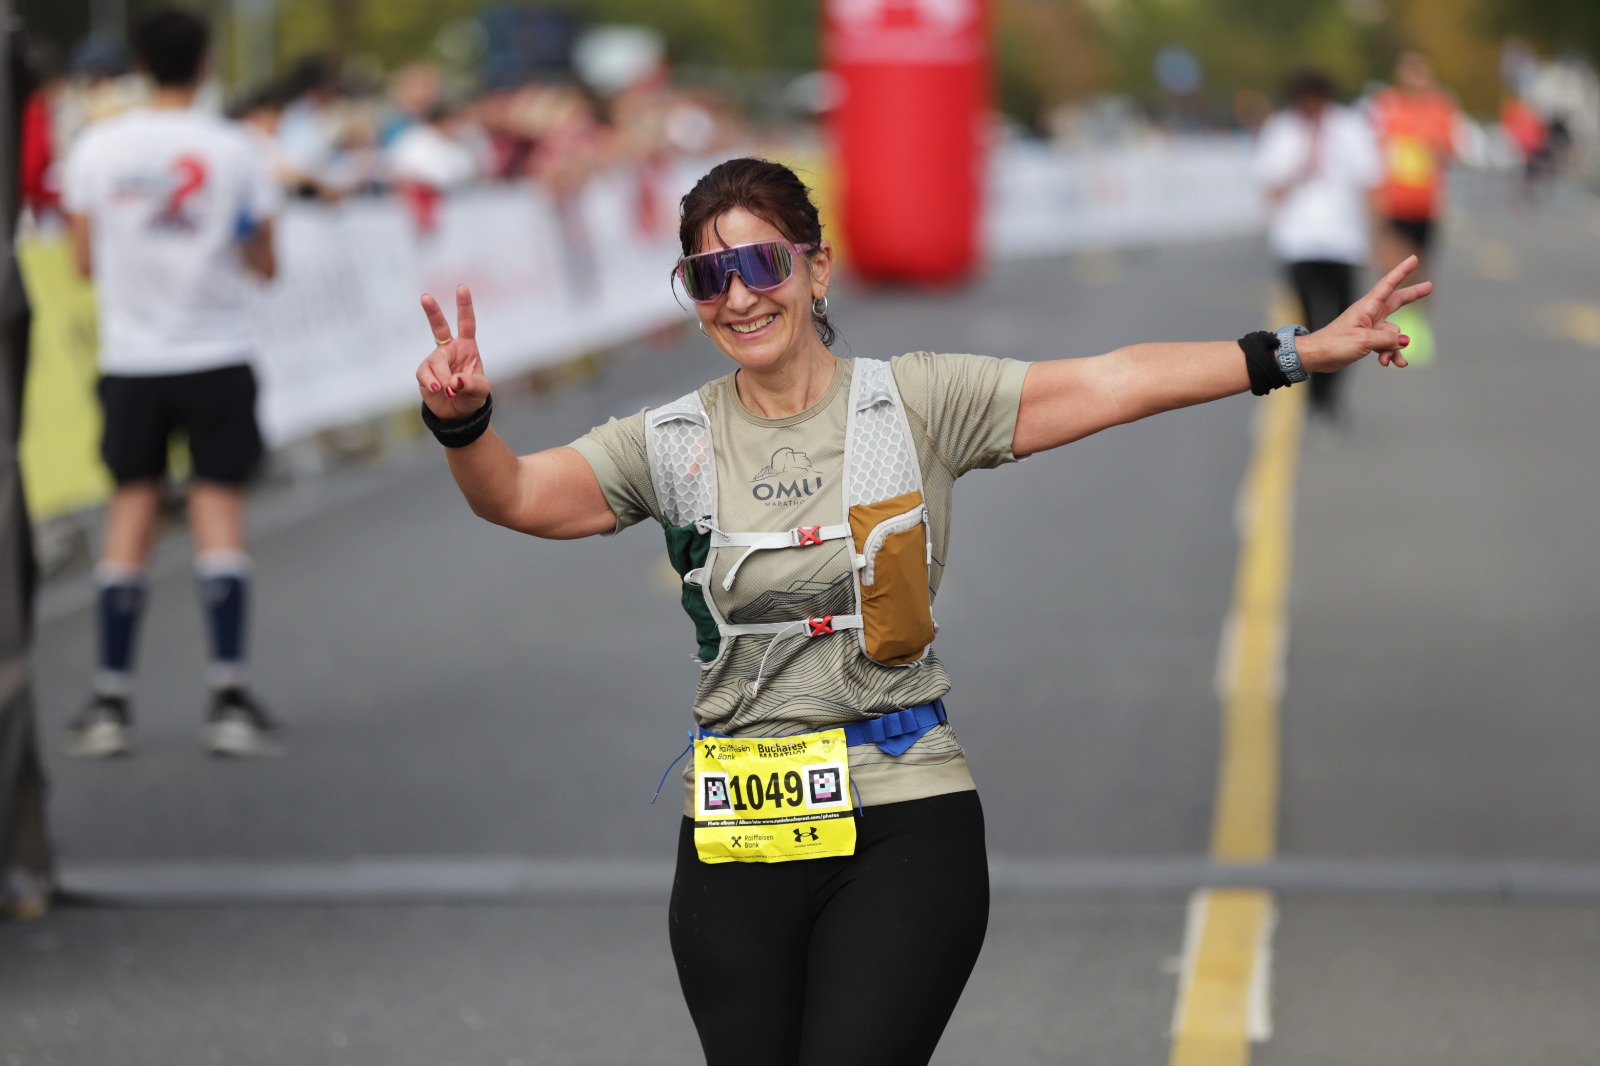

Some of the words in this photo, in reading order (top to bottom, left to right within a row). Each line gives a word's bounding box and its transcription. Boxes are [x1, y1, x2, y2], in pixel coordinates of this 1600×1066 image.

[753, 477, 822, 501] OMU
[765, 499, 805, 507] MARATHO
[757, 741, 808, 753] Bucharest
[730, 770, 803, 811] 1049
[744, 834, 774, 842] Raiffeisen
